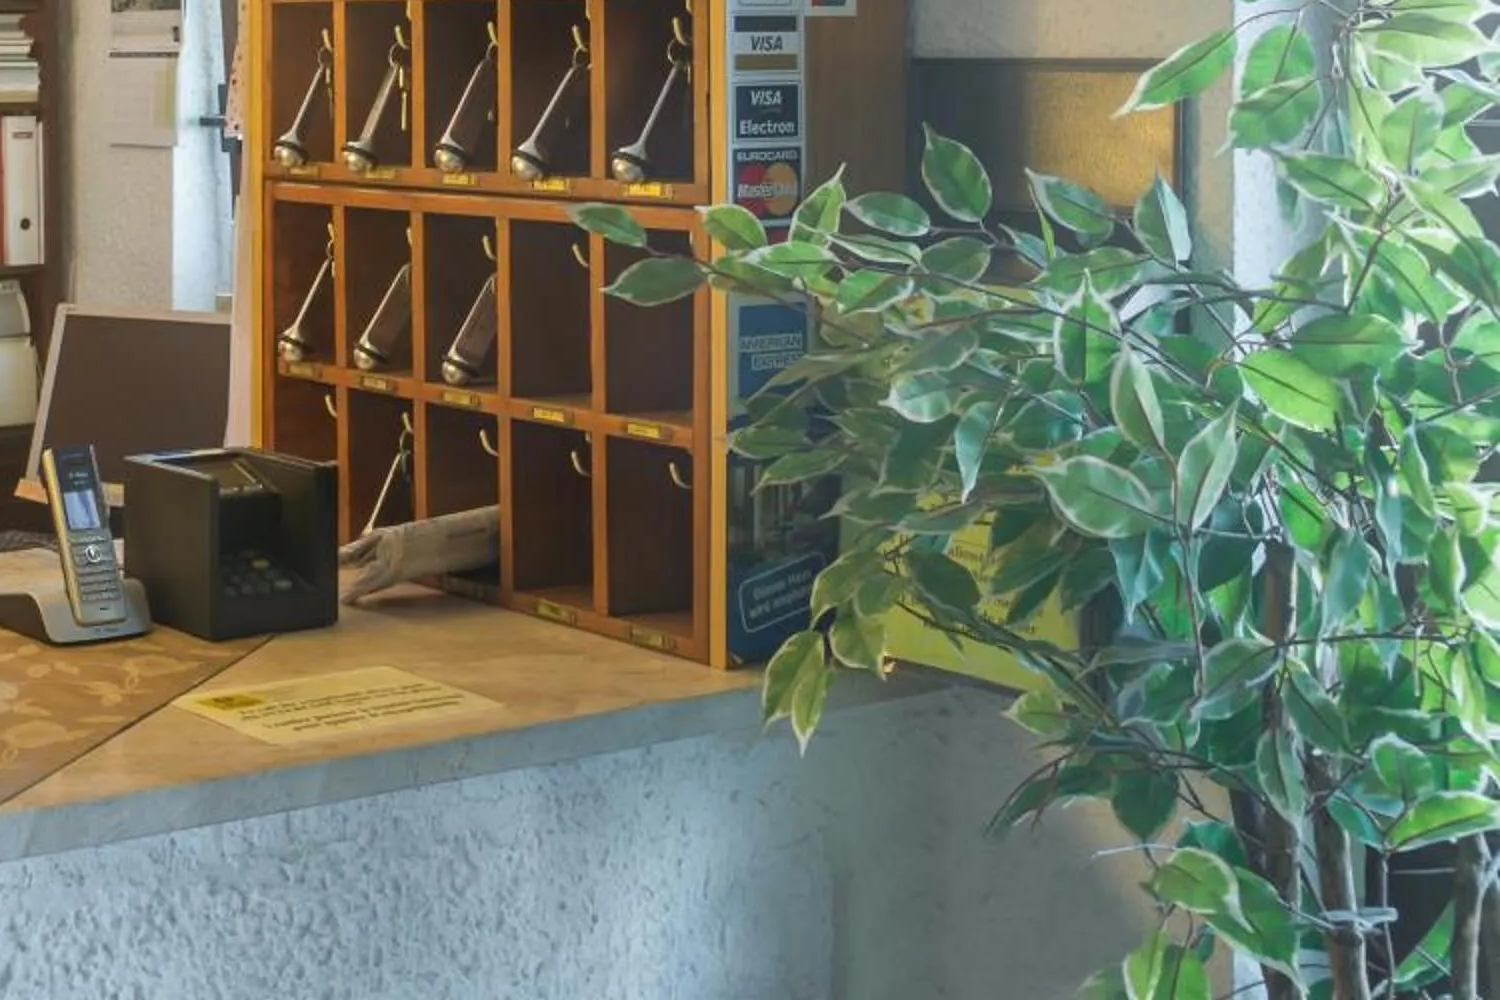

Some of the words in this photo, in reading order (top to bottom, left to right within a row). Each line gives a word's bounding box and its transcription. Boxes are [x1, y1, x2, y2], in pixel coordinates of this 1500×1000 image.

[750, 35, 784, 51] VISA
[750, 90, 784, 106] VISA
[739, 119, 795, 135] Electron
